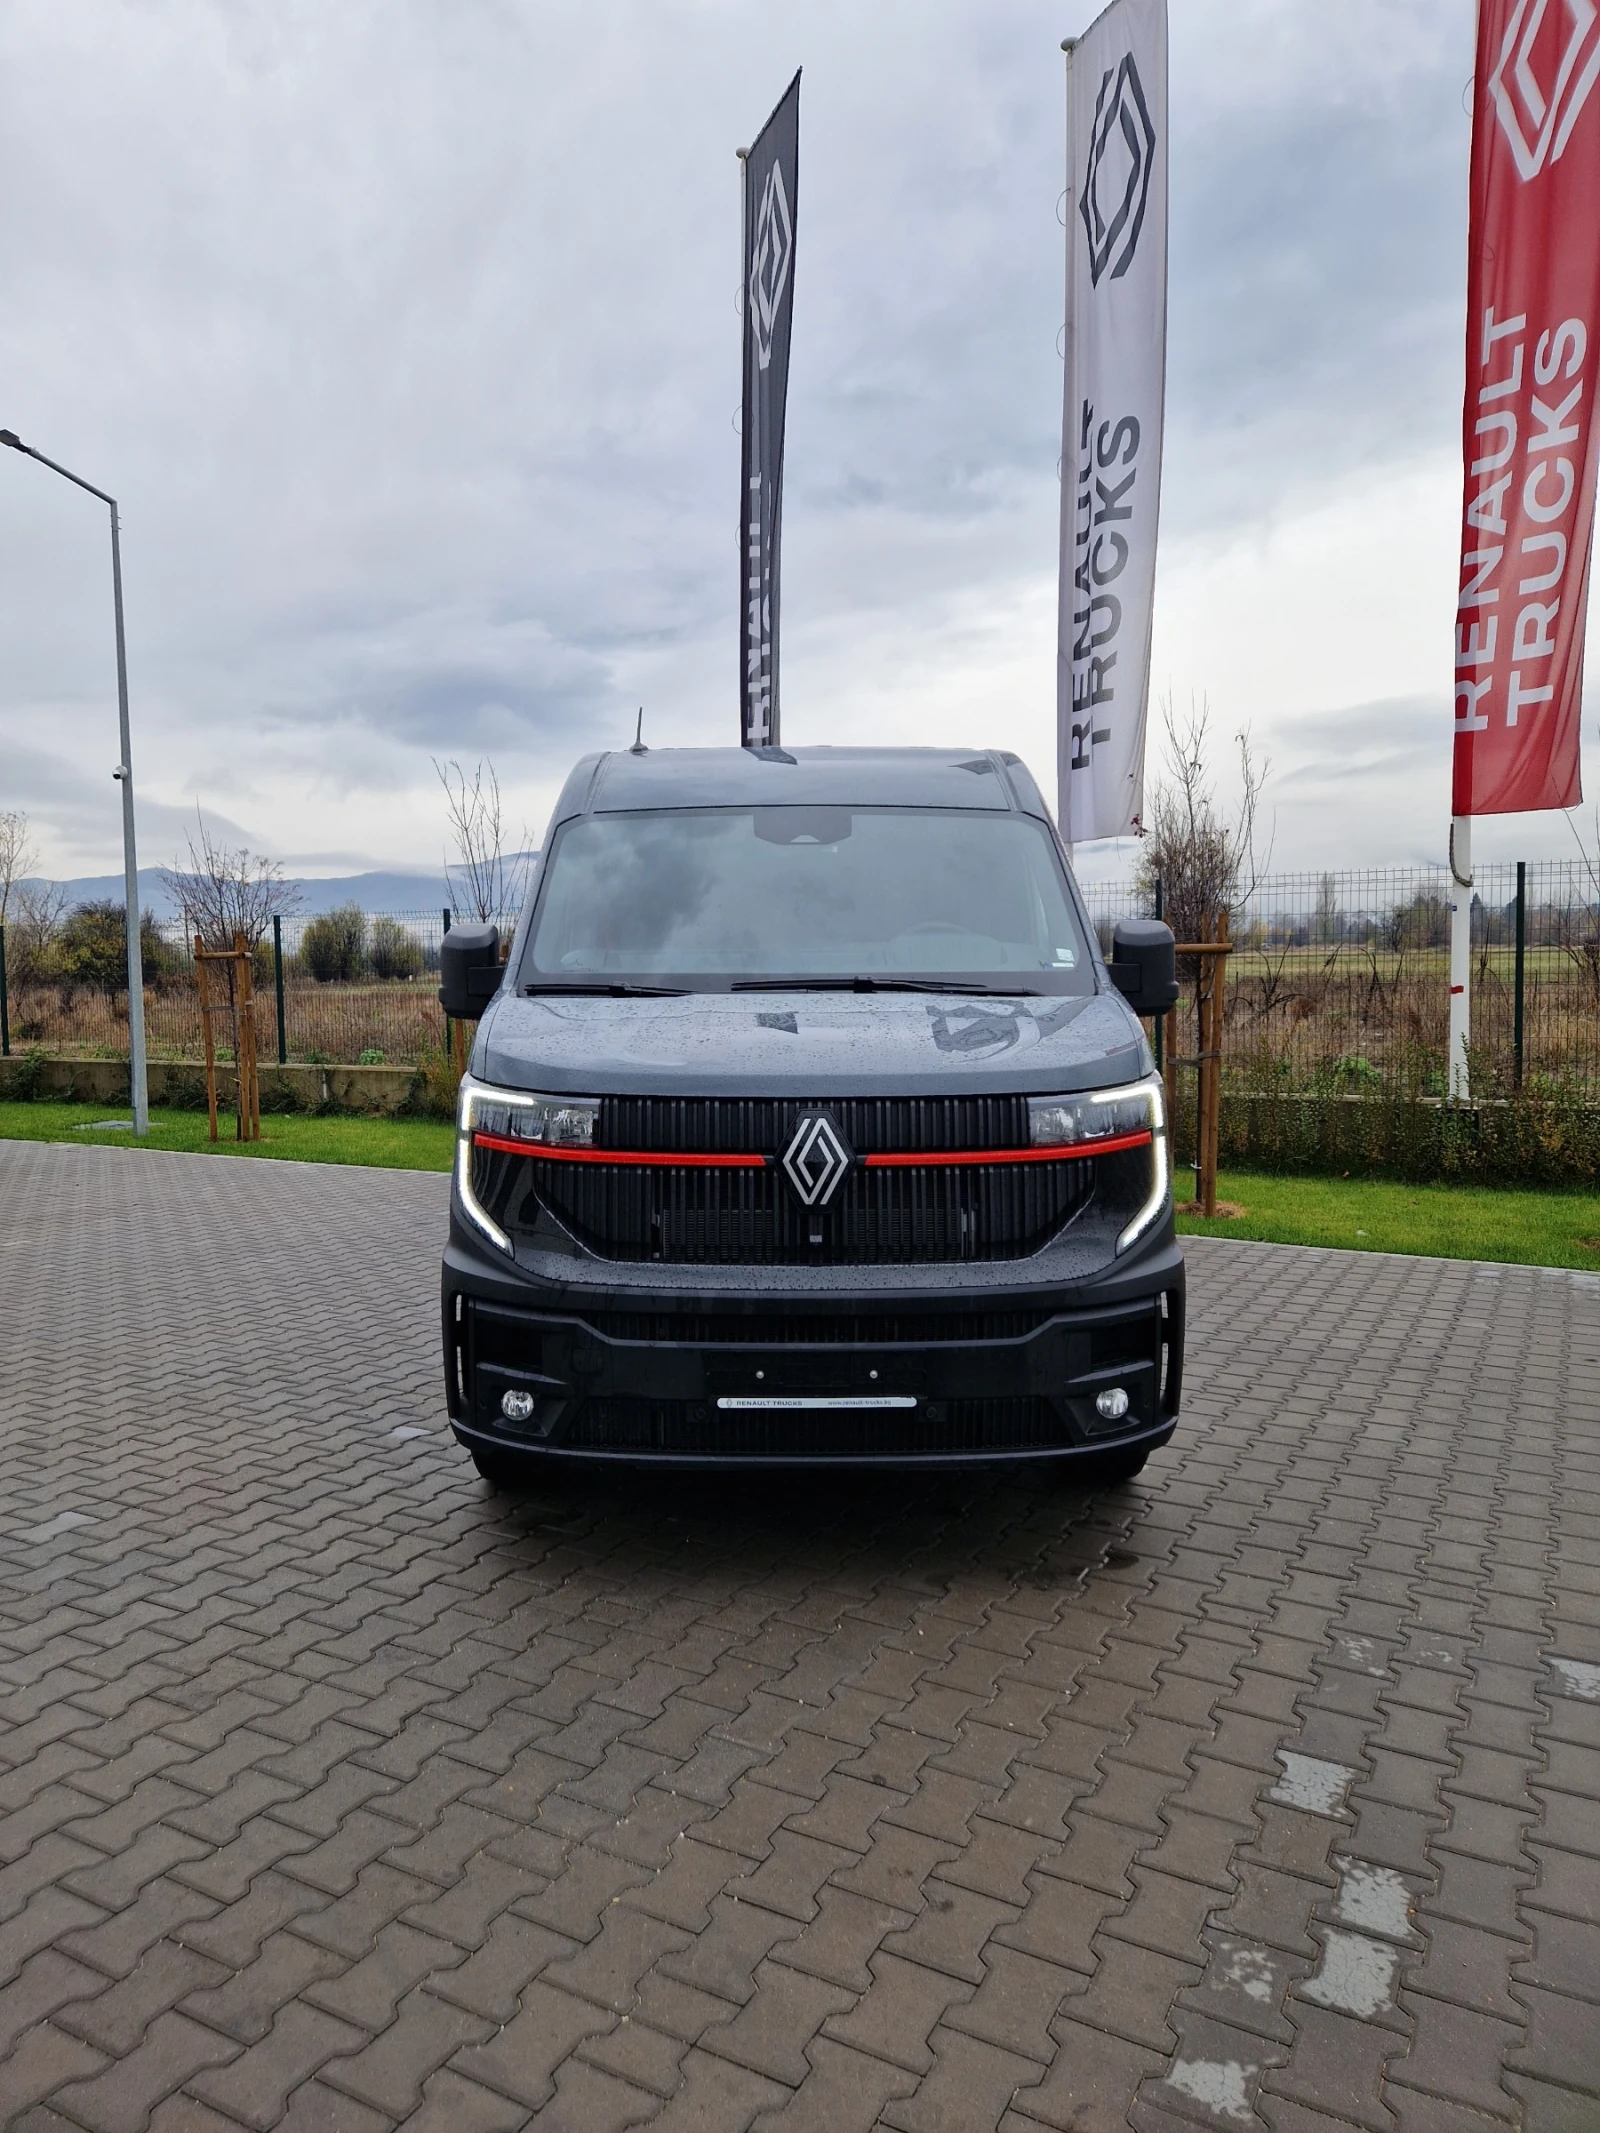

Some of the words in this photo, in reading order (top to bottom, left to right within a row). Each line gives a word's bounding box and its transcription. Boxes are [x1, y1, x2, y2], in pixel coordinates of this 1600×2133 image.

[1091, 415, 1141, 745] TRUCKS
[1454, 305, 1527, 733] RENAULT
[1506, 317, 1589, 728] TRUCKS
